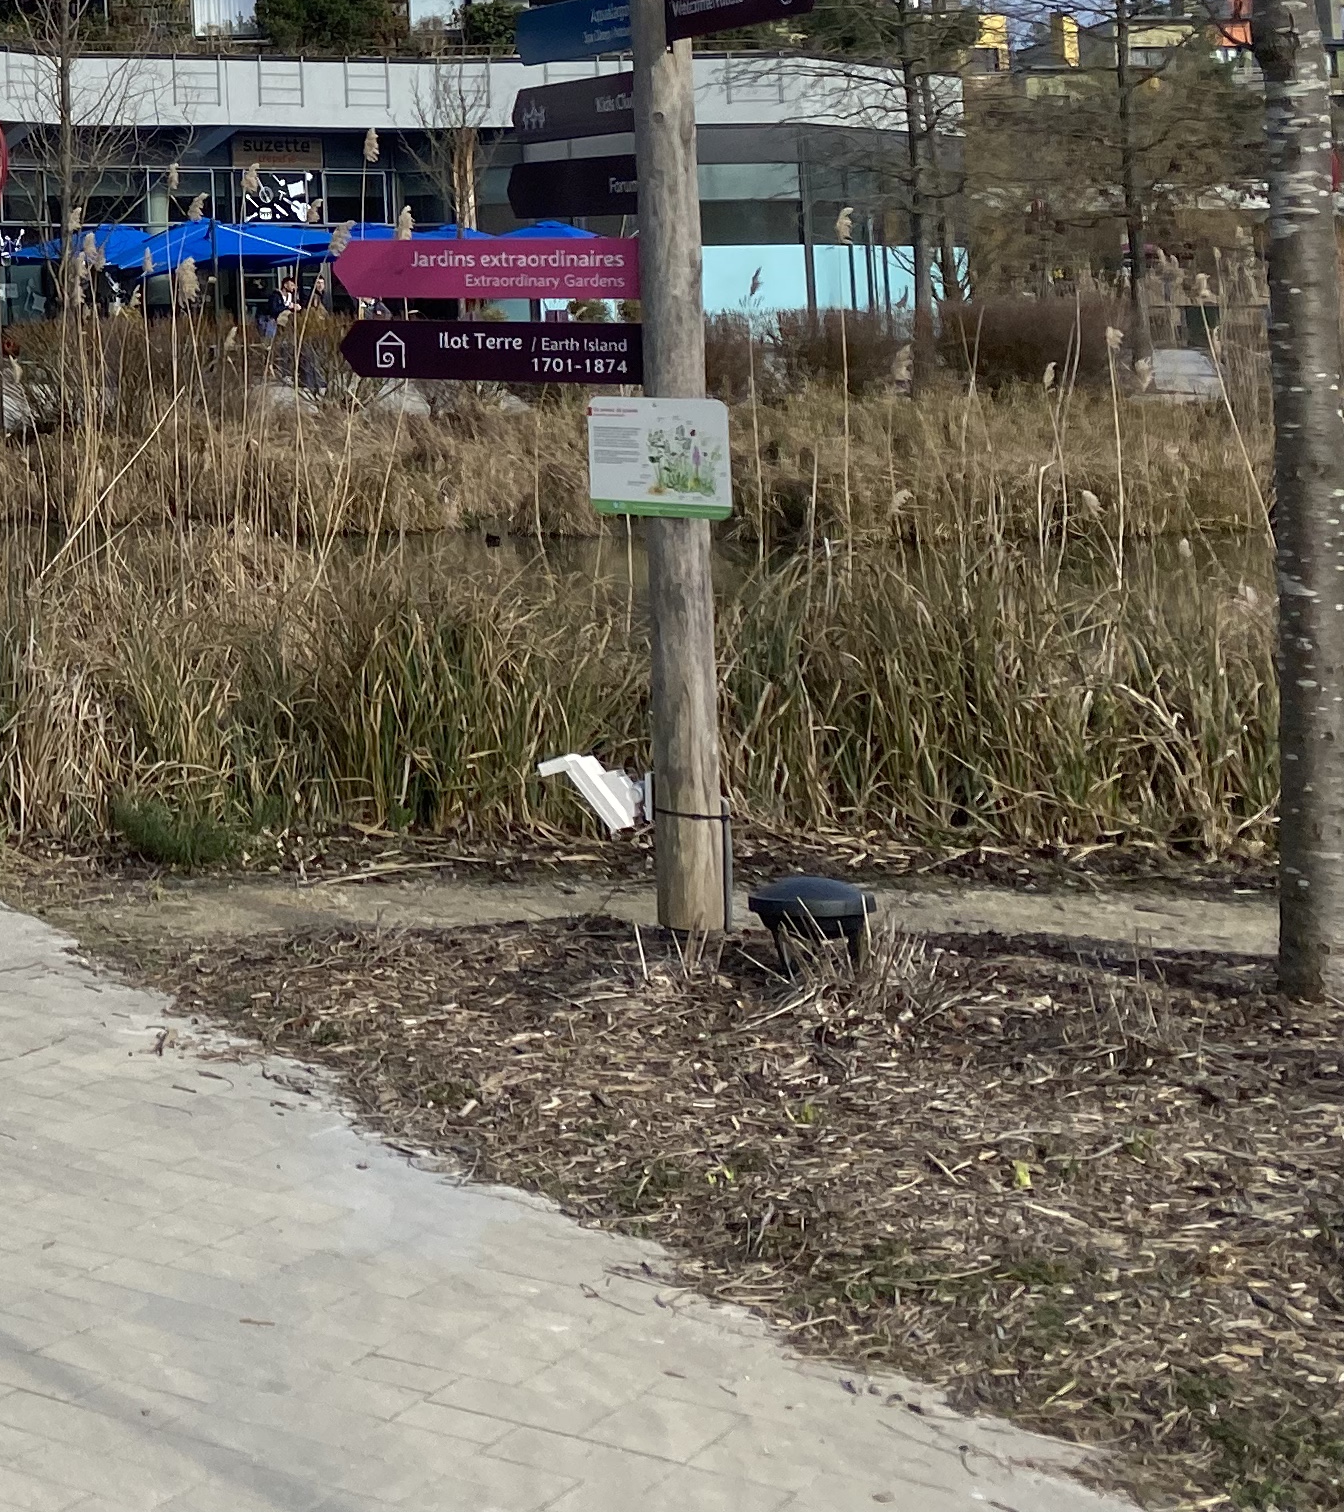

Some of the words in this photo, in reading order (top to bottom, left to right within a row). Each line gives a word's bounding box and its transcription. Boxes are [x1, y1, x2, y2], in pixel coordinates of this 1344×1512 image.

[615, 92, 633, 110] Clu
[242, 138, 310, 153] suzette
[411, 250, 476, 268] Jardins
[480, 250, 625, 268] extraordinaires
[465, 273, 560, 289] Extraordinary
[564, 274, 625, 288] Gardens
[439, 331, 470, 350] Ilot
[474, 332, 523, 350] Terre
[541, 337, 580, 352] Earth
[583, 337, 628, 353] Island
[531, 357, 628, 374] 1701-1874
